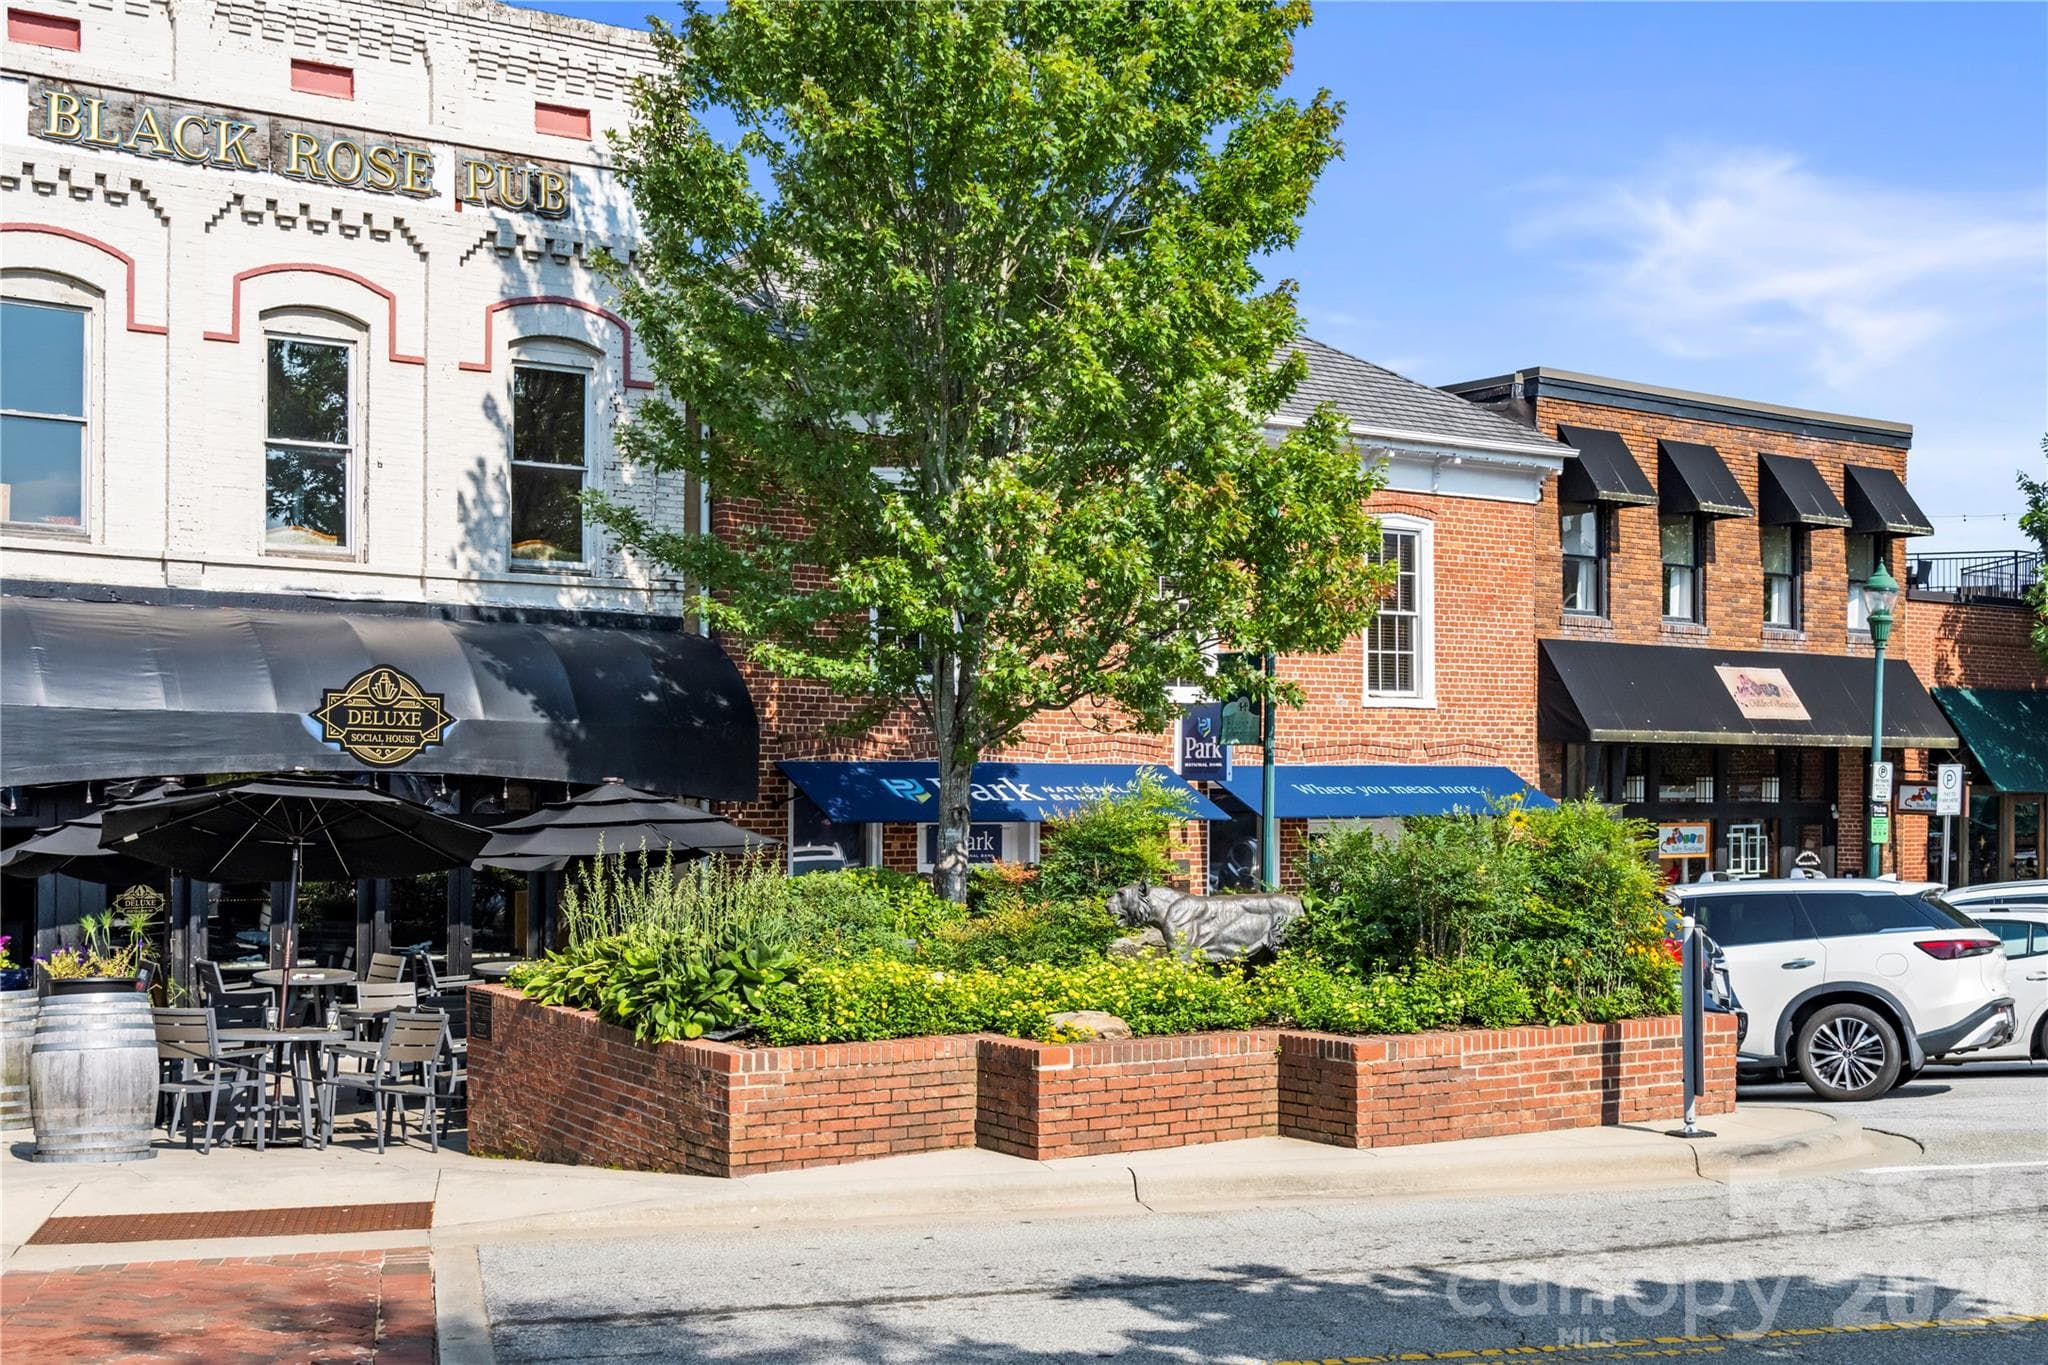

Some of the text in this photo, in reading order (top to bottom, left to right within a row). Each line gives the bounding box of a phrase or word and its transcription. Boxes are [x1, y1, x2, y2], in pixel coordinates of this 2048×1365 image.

[41, 90, 569, 216] BLACK ROSE PUB
[347, 709, 422, 727] DELUXE
[351, 733, 416, 744] SOCIAL HOUSE
[1184, 736, 1222, 759] Park
[925, 777, 1047, 801] ark
[1291, 783, 1356, 795] Where
[1356, 786, 1390, 797] you
[1390, 785, 1440, 794] mean
[967, 831, 994, 851] ark
[125, 899, 156, 907] DELUXE
